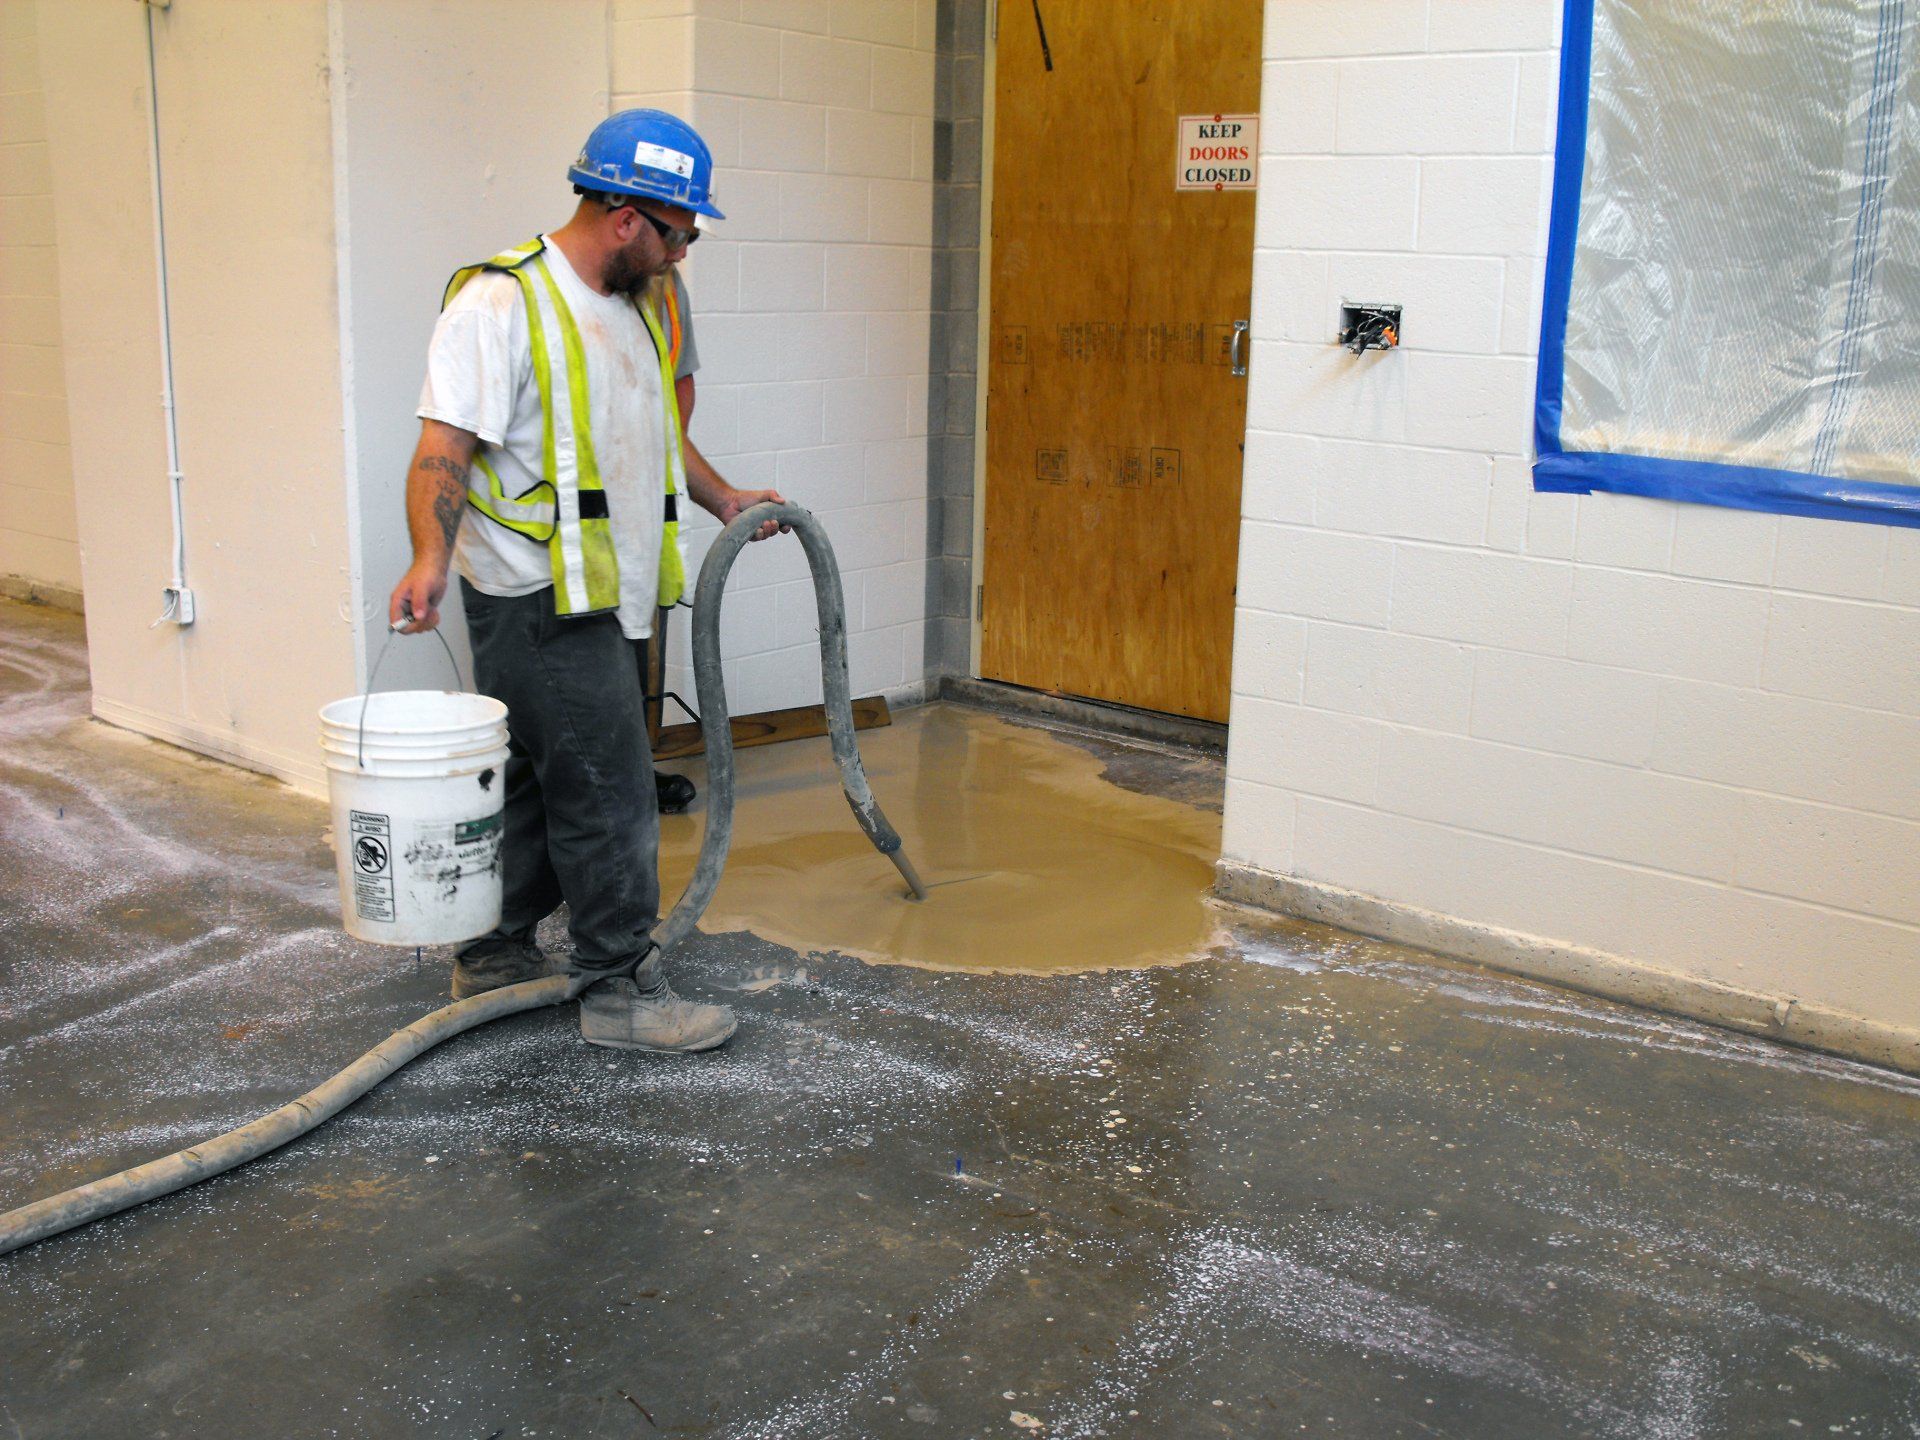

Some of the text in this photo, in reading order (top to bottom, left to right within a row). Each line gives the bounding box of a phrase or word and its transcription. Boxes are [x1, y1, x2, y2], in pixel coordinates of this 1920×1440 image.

[1198, 124, 1242, 139] KEEP
[1189, 146, 1249, 161] DOORS
[1185, 168, 1251, 183] CLOSED
[358, 815, 386, 823] WARNING
